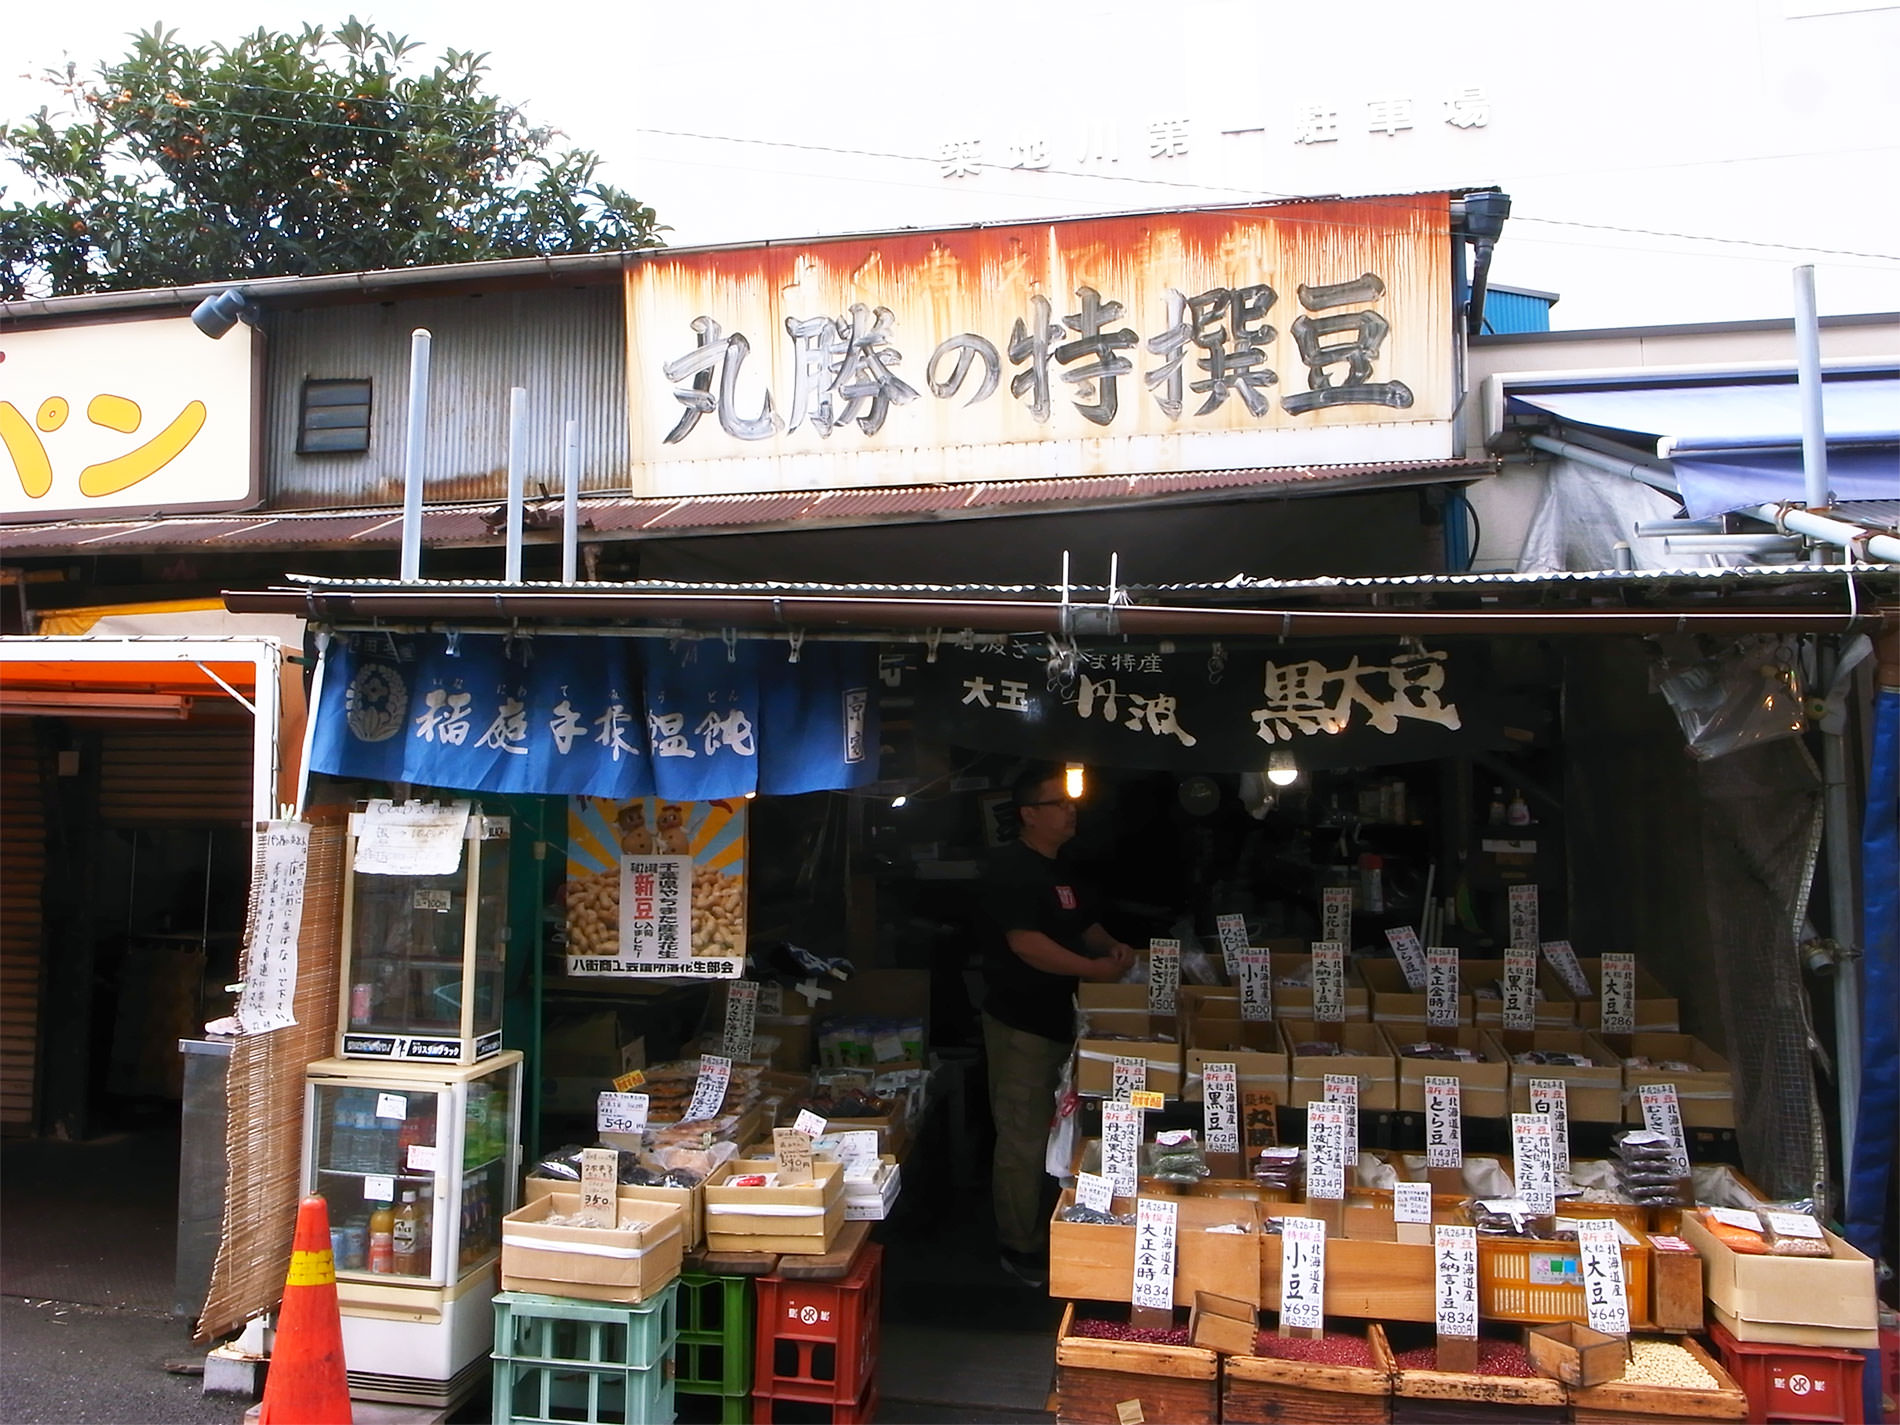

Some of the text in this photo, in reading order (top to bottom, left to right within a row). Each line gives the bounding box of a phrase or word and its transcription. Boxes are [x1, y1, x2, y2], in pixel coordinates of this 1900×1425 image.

[937, 87, 1492, 178] 築地川第一駐車場
[663, 273, 1414, 446] 丸勝の特撰豆
[0, 393, 208, 499] パン
[961, 651, 1462, 748] 大玉 丹波 黒大豆
[633, 874, 655, 920] 新豆
[644, 923, 654, 937] 入荷
[1326, 903, 1340, 940] 白花豆
[1149, 955, 1166, 999] ささげ
[1396, 941, 1420, 974] とら豆
[1241, 963, 1259, 1004] 小豆
[1315, 960, 1332, 1004] 大納言小豆
[1429, 965, 1445, 1008] 大正金時
[1506, 975, 1523, 1011] 黒豆
[1604, 978, 1621, 1015] 大豆
[1242, 1004, 1270, 1015] ¥300
[1315, 1004, 1343, 1014] ¥371
[1428, 1009, 1457, 1019] ¥371
[1603, 1016, 1633, 1026] ¥286
[1114, 1075, 1131, 1102] ひた
[1225, 1083, 1236, 1125] 北海道産
[1532, 1089, 1565, 1099] 新豆
[1104, 1112, 1137, 1123] 新豆
[1206, 1091, 1224, 1132] 黒豆
[1309, 1113, 1343, 1123] 新豆
[1345, 1095, 1356, 1138] 北海道産
[1429, 1095, 1448, 1146] とら豆
[1447, 1096, 1459, 1140] 北海道産
[1514, 1125, 1550, 1135] 新豆
[1553, 1100, 1567, 1143] 北海道産
[1667, 1105, 1684, 1149] 北海道産
[1104, 1122, 1122, 1175] 丹波黒大豆
[1206, 1133, 1237, 1143] 762円
[1309, 1123, 1327, 1176] 丹波黒大豆
[1427, 1148, 1460, 1158] 1143円
[1516, 1136, 1537, 1190] むらさき花豆
[1539, 1136, 1552, 1183] 信州特産
[1308, 1178, 1343, 1189] 3334円
[1139, 1211, 1176, 1225] 特撰豆
[1286, 1230, 1322, 1243] 特撰豆
[1580, 1232, 1617, 1243] 新豆
[1136, 1224, 1158, 1281] 大正金時
[1160, 1225, 1174, 1276] 北海道産
[1437, 1238, 1475, 1250] 新豆
[1135, 1282, 1169, 1296] ¥834
[1286, 1241, 1307, 1301] 小豆
[1309, 1243, 1321, 1295] 北海道産
[1439, 1249, 1460, 1309] 大納言小豆
[1462, 1250, 1476, 1303] 北海道産
[1587, 1254, 1608, 1306] 大豆
[1607, 1243, 1623, 1297] 北海道産
[1283, 1301, 1320, 1317] ¥695
[1437, 1311, 1475, 1325] ¥834
[1589, 1307, 1626, 1321] ¥649
